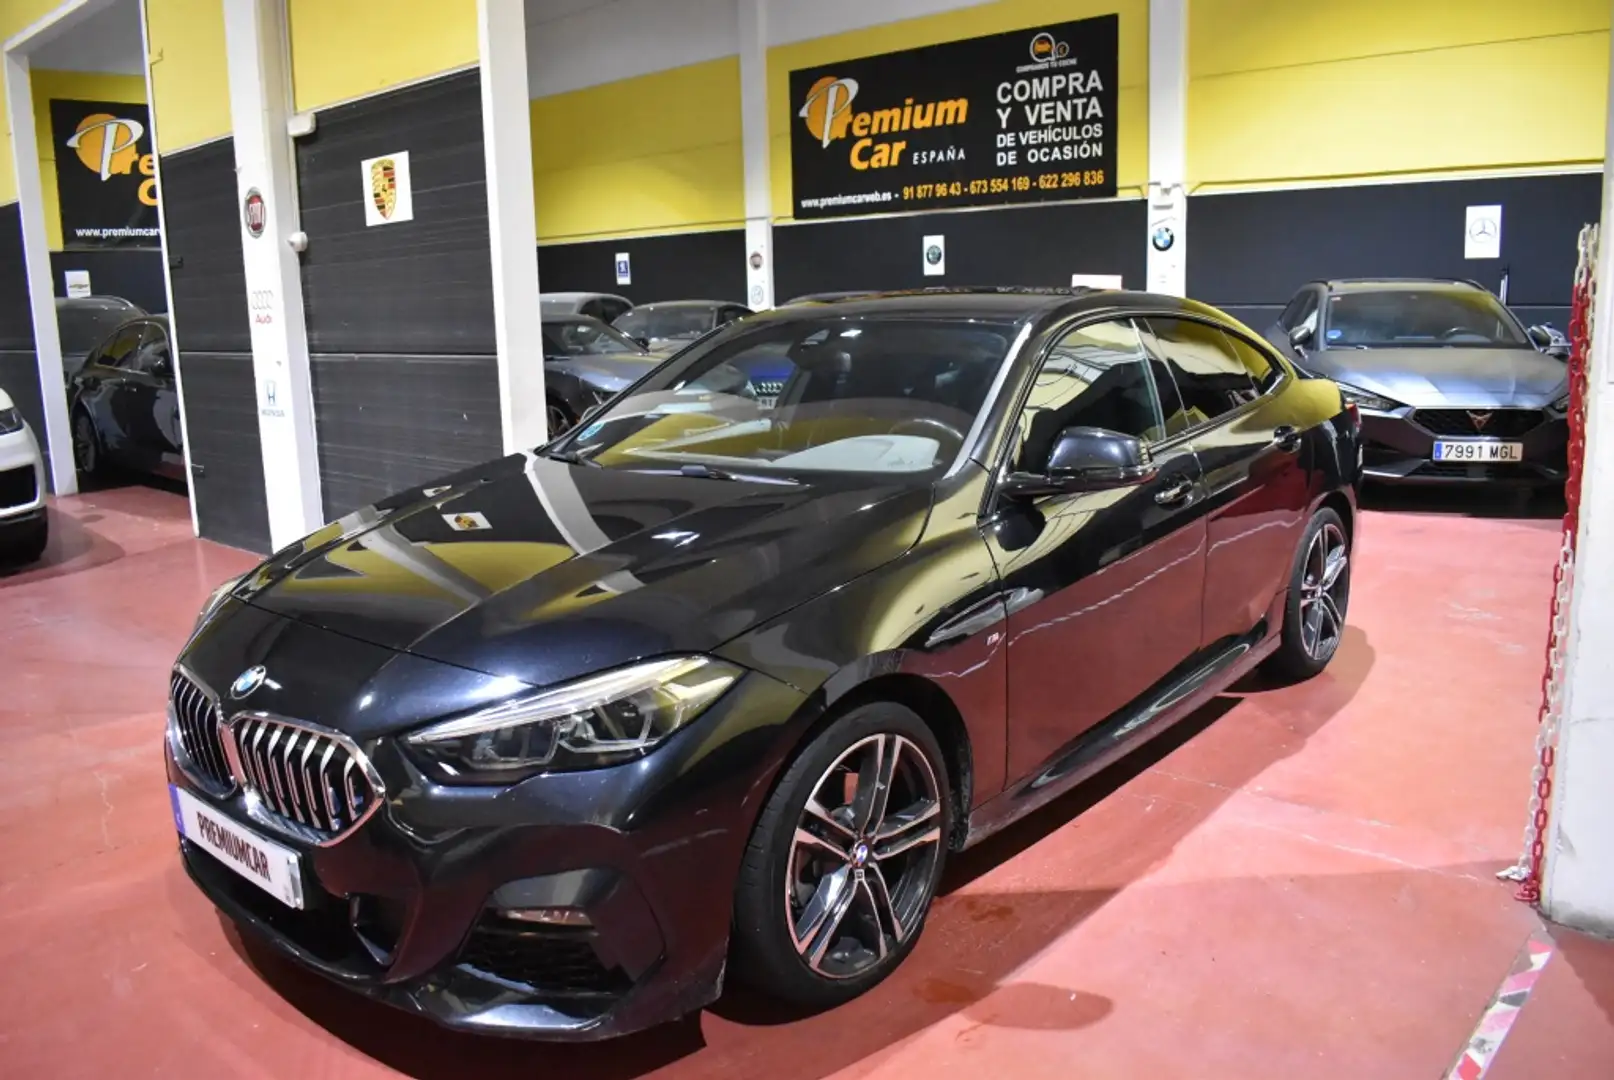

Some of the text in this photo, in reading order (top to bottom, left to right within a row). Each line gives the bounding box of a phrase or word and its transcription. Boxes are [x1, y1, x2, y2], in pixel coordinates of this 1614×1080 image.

[996, 69, 1103, 104] COMPRA
[798, 77, 969, 149] Premium
[996, 96, 1103, 129] Y VENTA
[996, 123, 1103, 148] DE VEHÍCULOS
[850, 138, 966, 171] Car ESPAÑA
[996, 141, 1103, 167] DE OCASIÓN
[801, 191, 892, 209] www.premiumcarweb.es
[903, 186, 914, 200] 91
[916, 184, 933, 198] 877
[935, 183, 947, 197] 96
[949, 181, 962, 196] 43
[970, 179, 988, 195] 673
[990, 178, 1009, 193] 554
[1011, 176, 1030, 191] 169
[1039, 174, 1059, 189] 622
[1061, 171, 1081, 187] 296
[1083, 170, 1105, 186] 836
[1445, 444, 1518, 460] 7991 MGL
[196, 811, 272, 882] PREMIUMCAR
